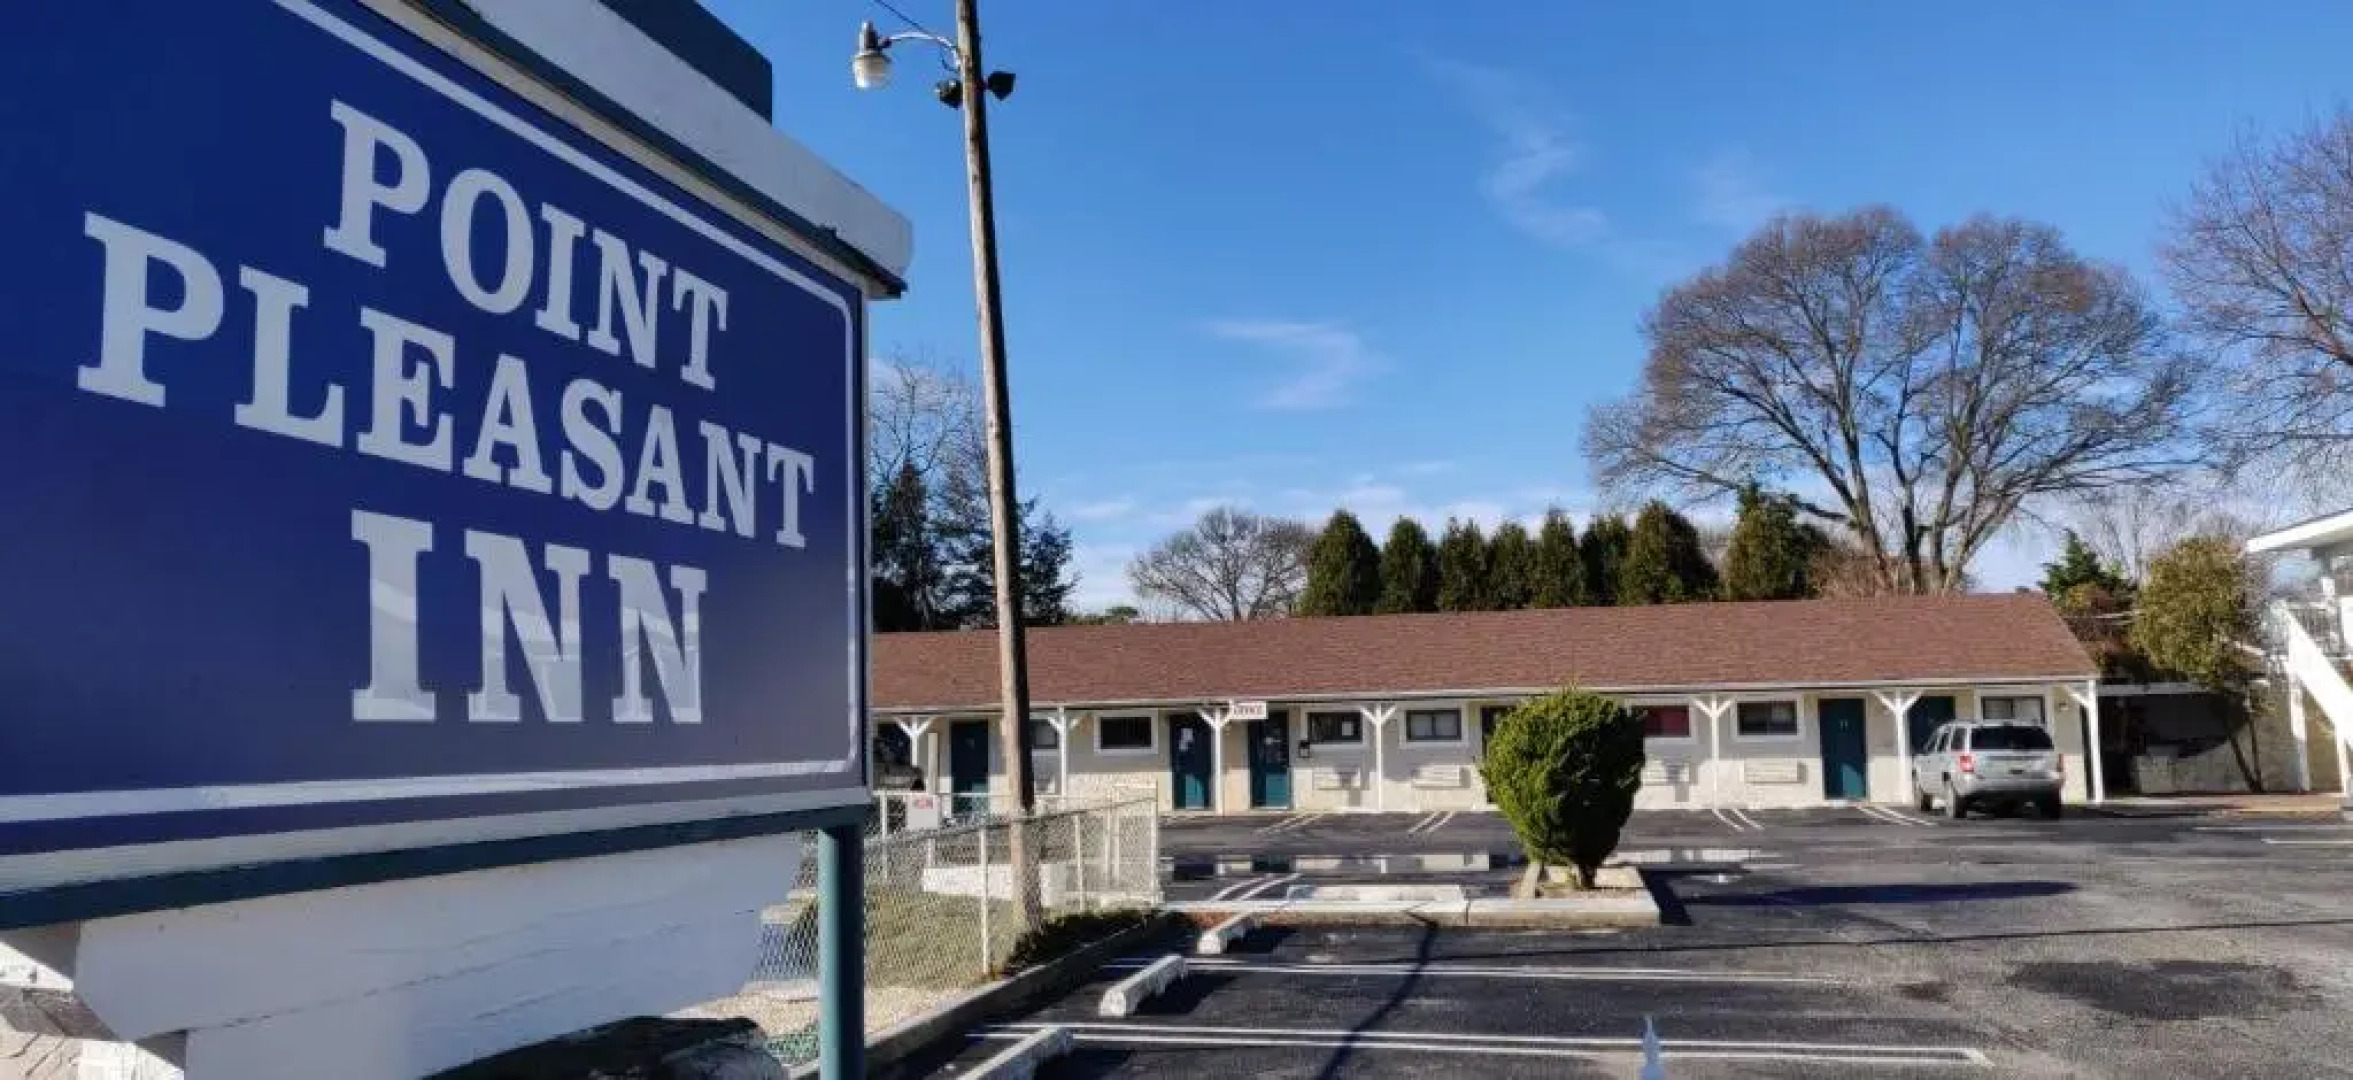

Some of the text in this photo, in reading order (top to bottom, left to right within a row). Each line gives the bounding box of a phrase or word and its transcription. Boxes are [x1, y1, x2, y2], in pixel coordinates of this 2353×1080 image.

[77, 211, 814, 548] PLEASANT
[324, 100, 727, 390] POINT
[351, 509, 707, 723] INN
